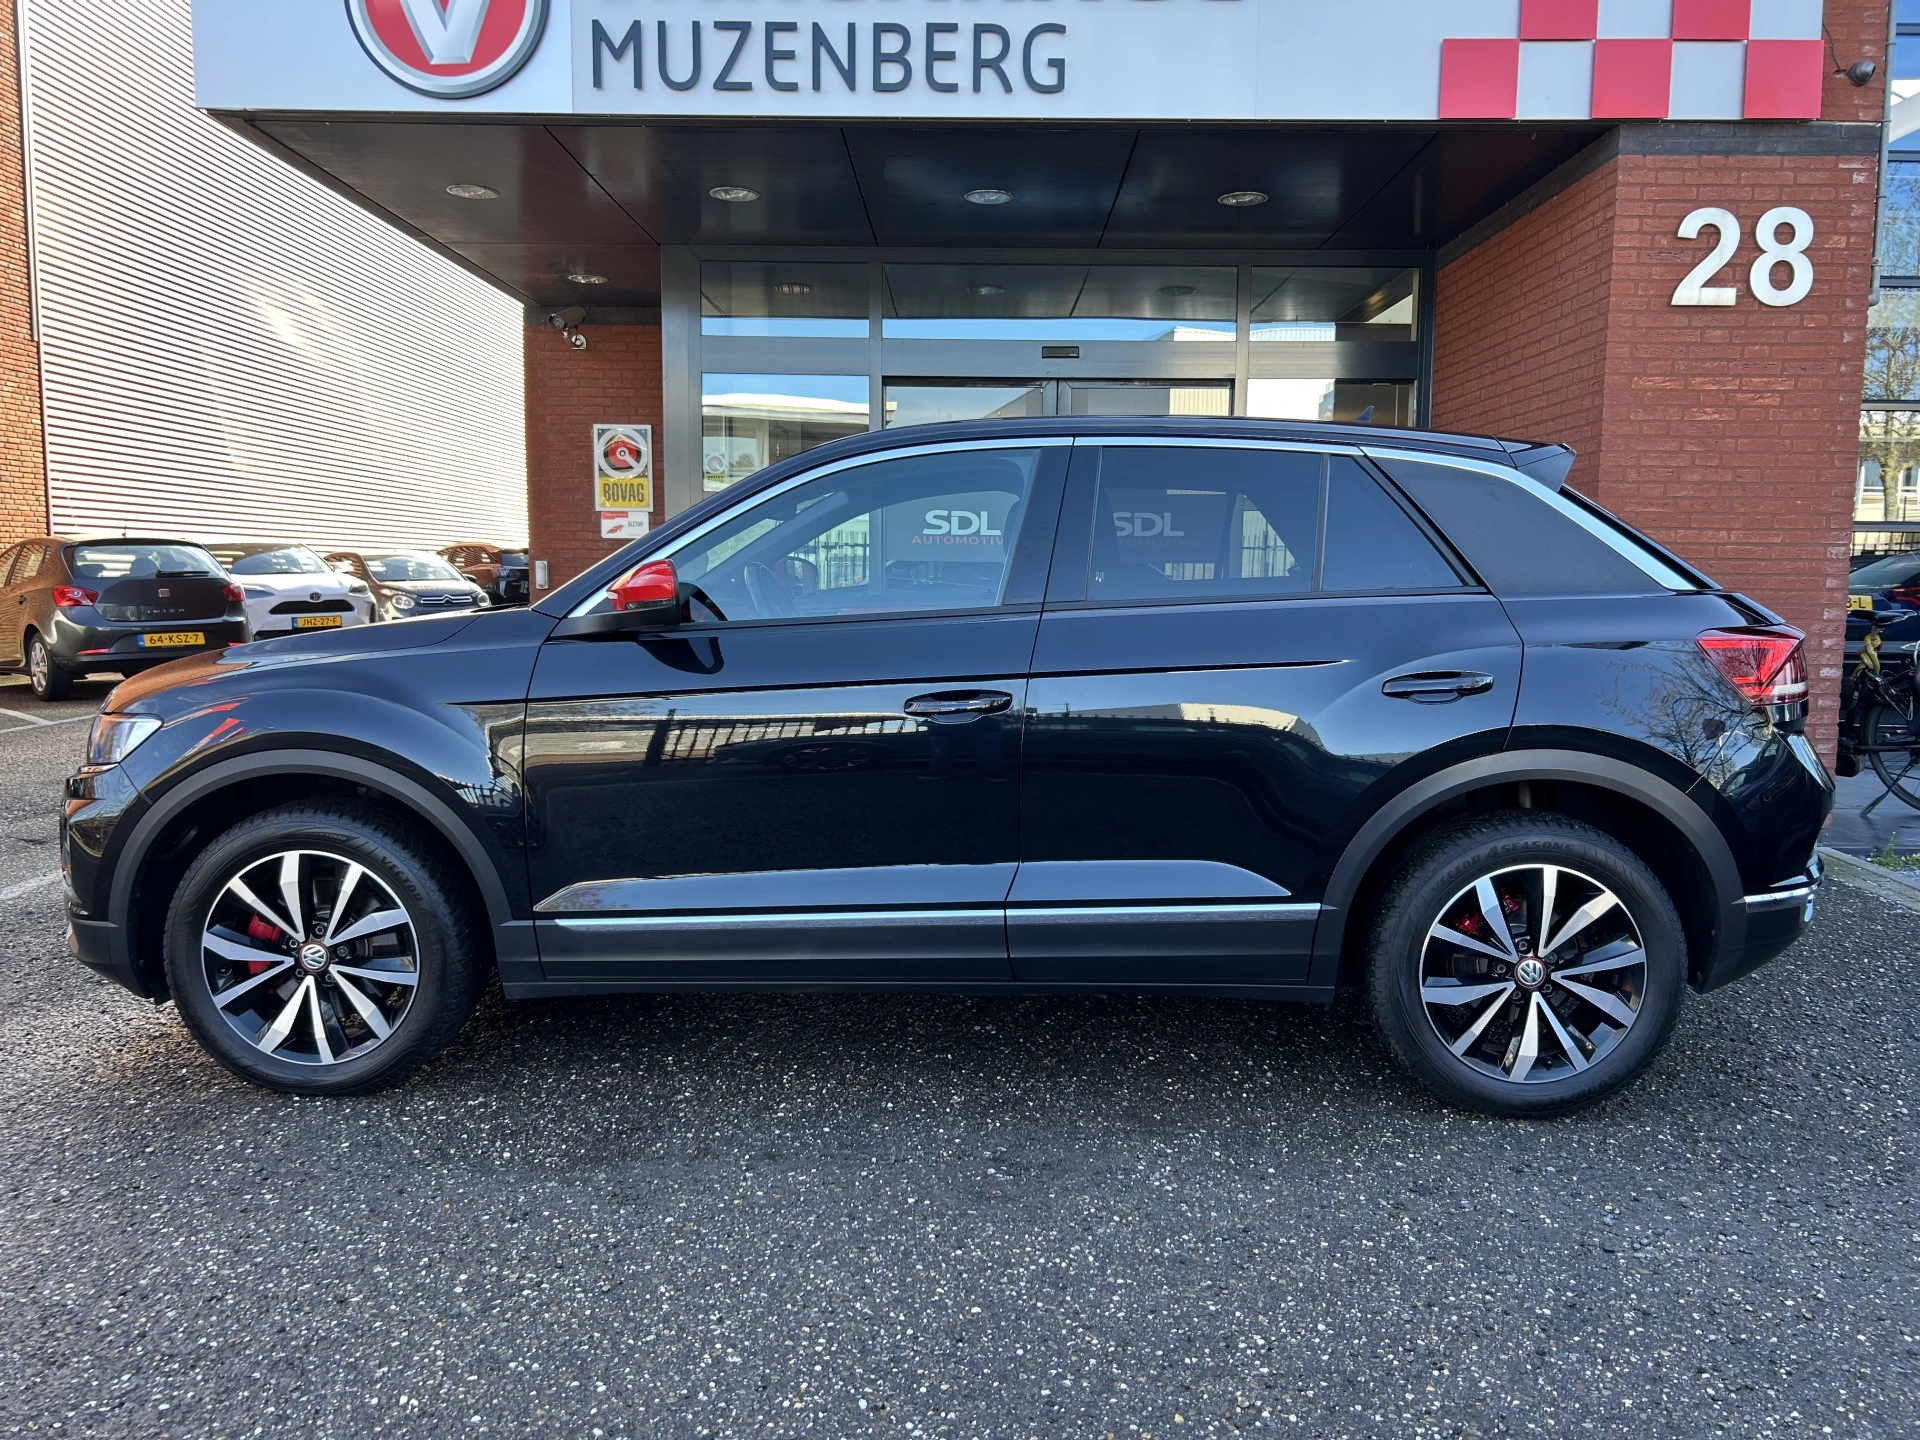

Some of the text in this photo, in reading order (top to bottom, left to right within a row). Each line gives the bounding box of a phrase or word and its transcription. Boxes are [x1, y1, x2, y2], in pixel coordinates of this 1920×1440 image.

[591, 19, 1067, 95] MUZENBERG
[1671, 206, 1815, 307] 28
[602, 483, 645, 503] BOVAG
[922, 509, 1002, 536] SDL
[302, 617, 338, 627] JHZ-27-F
[149, 633, 200, 645] 64-KSZ-7
